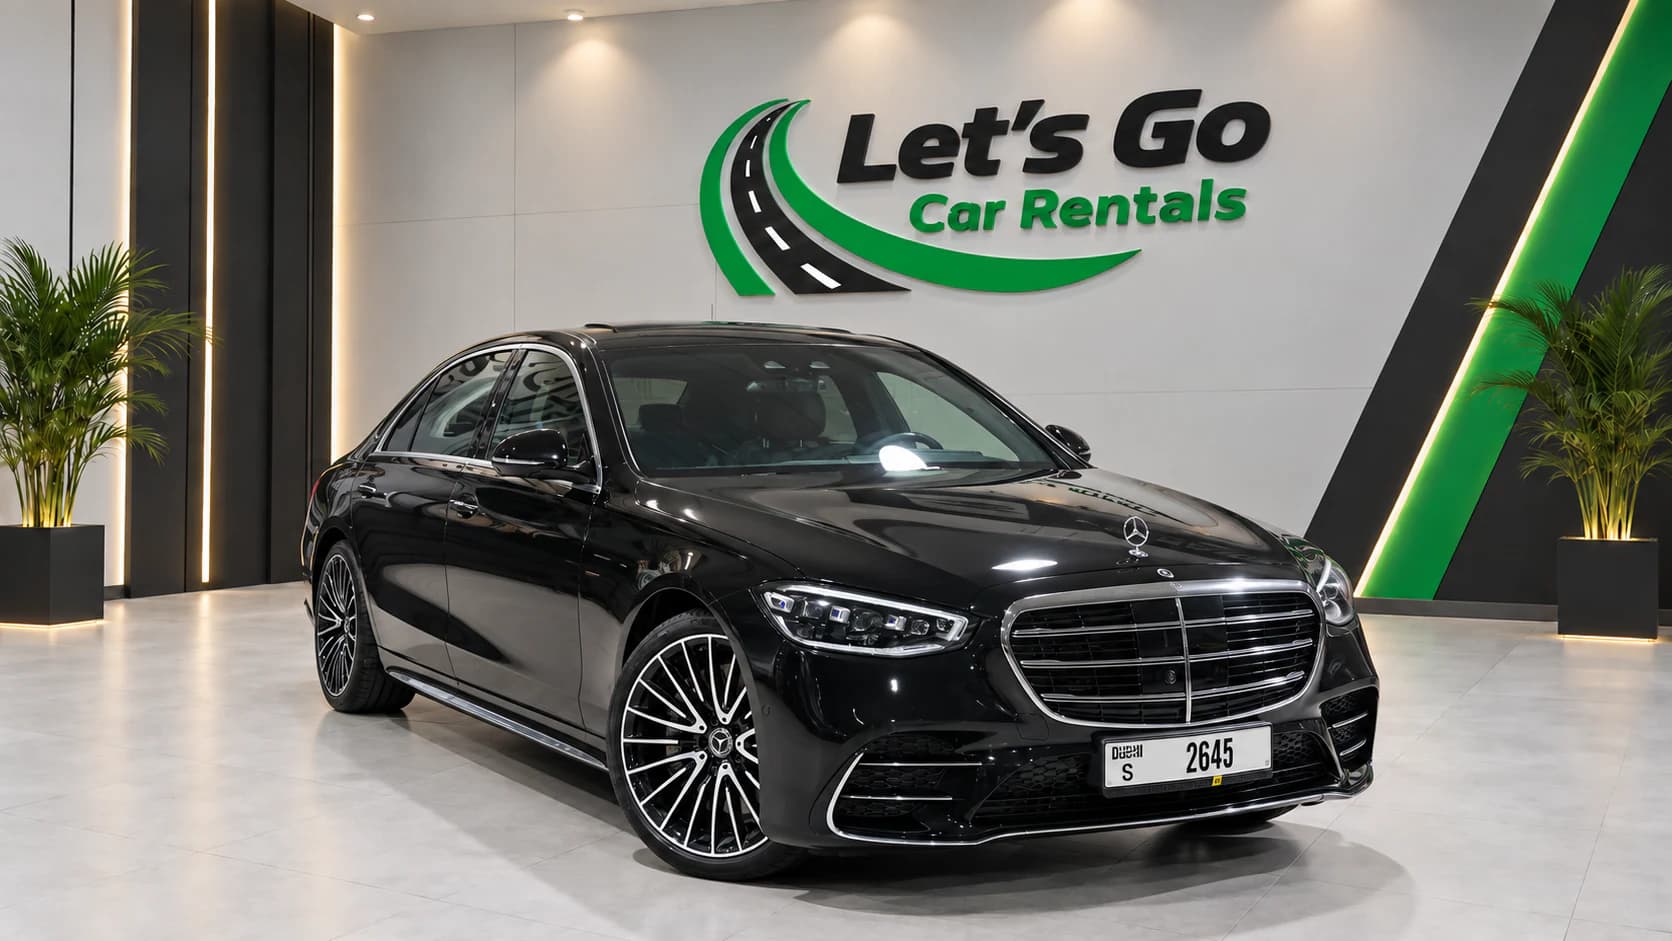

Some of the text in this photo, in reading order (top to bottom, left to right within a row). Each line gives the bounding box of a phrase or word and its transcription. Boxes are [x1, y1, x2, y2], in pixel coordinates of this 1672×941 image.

[837, 88, 1272, 185] Let's Go
[909, 178, 1247, 233] Car Rentals
[1121, 762, 1134, 782] S
[1185, 737, 1234, 774] 2645
